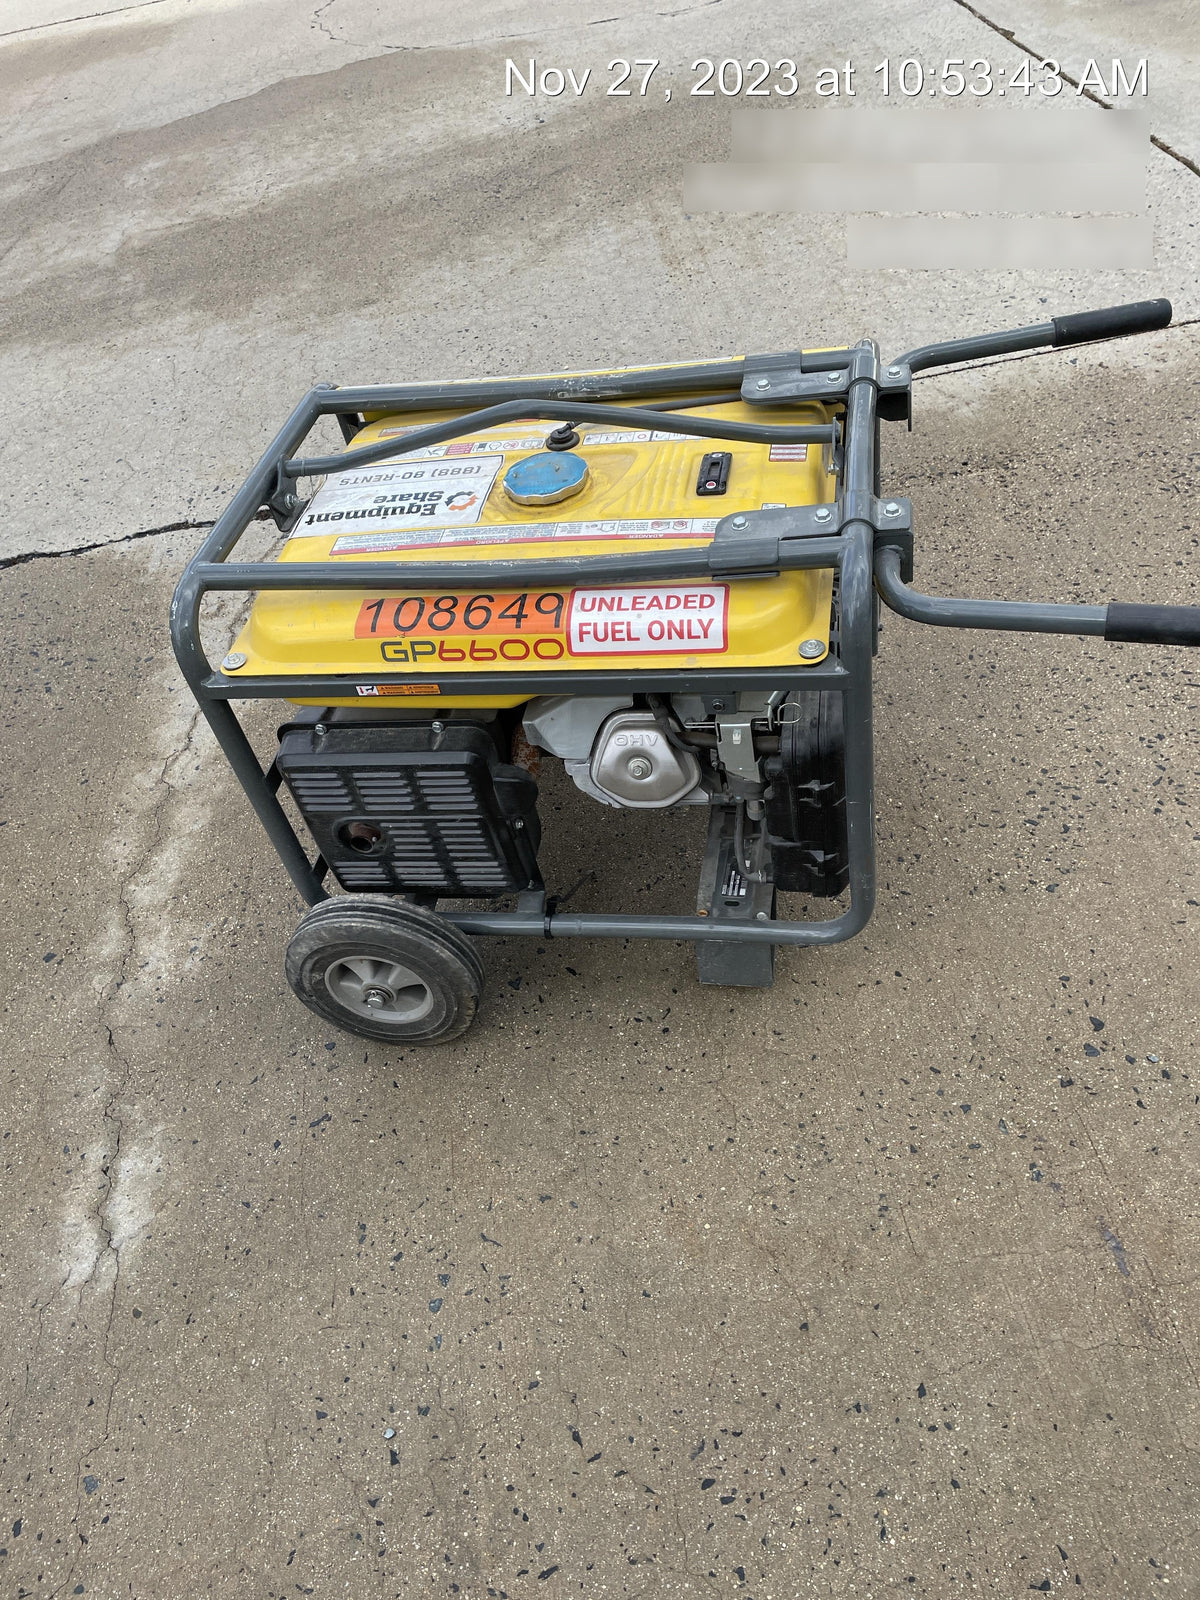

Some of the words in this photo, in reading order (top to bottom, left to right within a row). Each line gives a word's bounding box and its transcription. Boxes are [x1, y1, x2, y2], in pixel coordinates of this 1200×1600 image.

[339, 470, 427, 486] 80-RENTS
[431, 465, 482, 478] (888)
[373, 490, 445, 504] Share
[305, 502, 439, 525] Equipment
[365, 592, 564, 633] 108649
[579, 594, 716, 613] UNLEADED
[578, 620, 641, 643] FUEL
[647, 618, 715, 641] ONLY
[380, 638, 565, 663] GP6600
[614, 734, 659, 747] OHV
